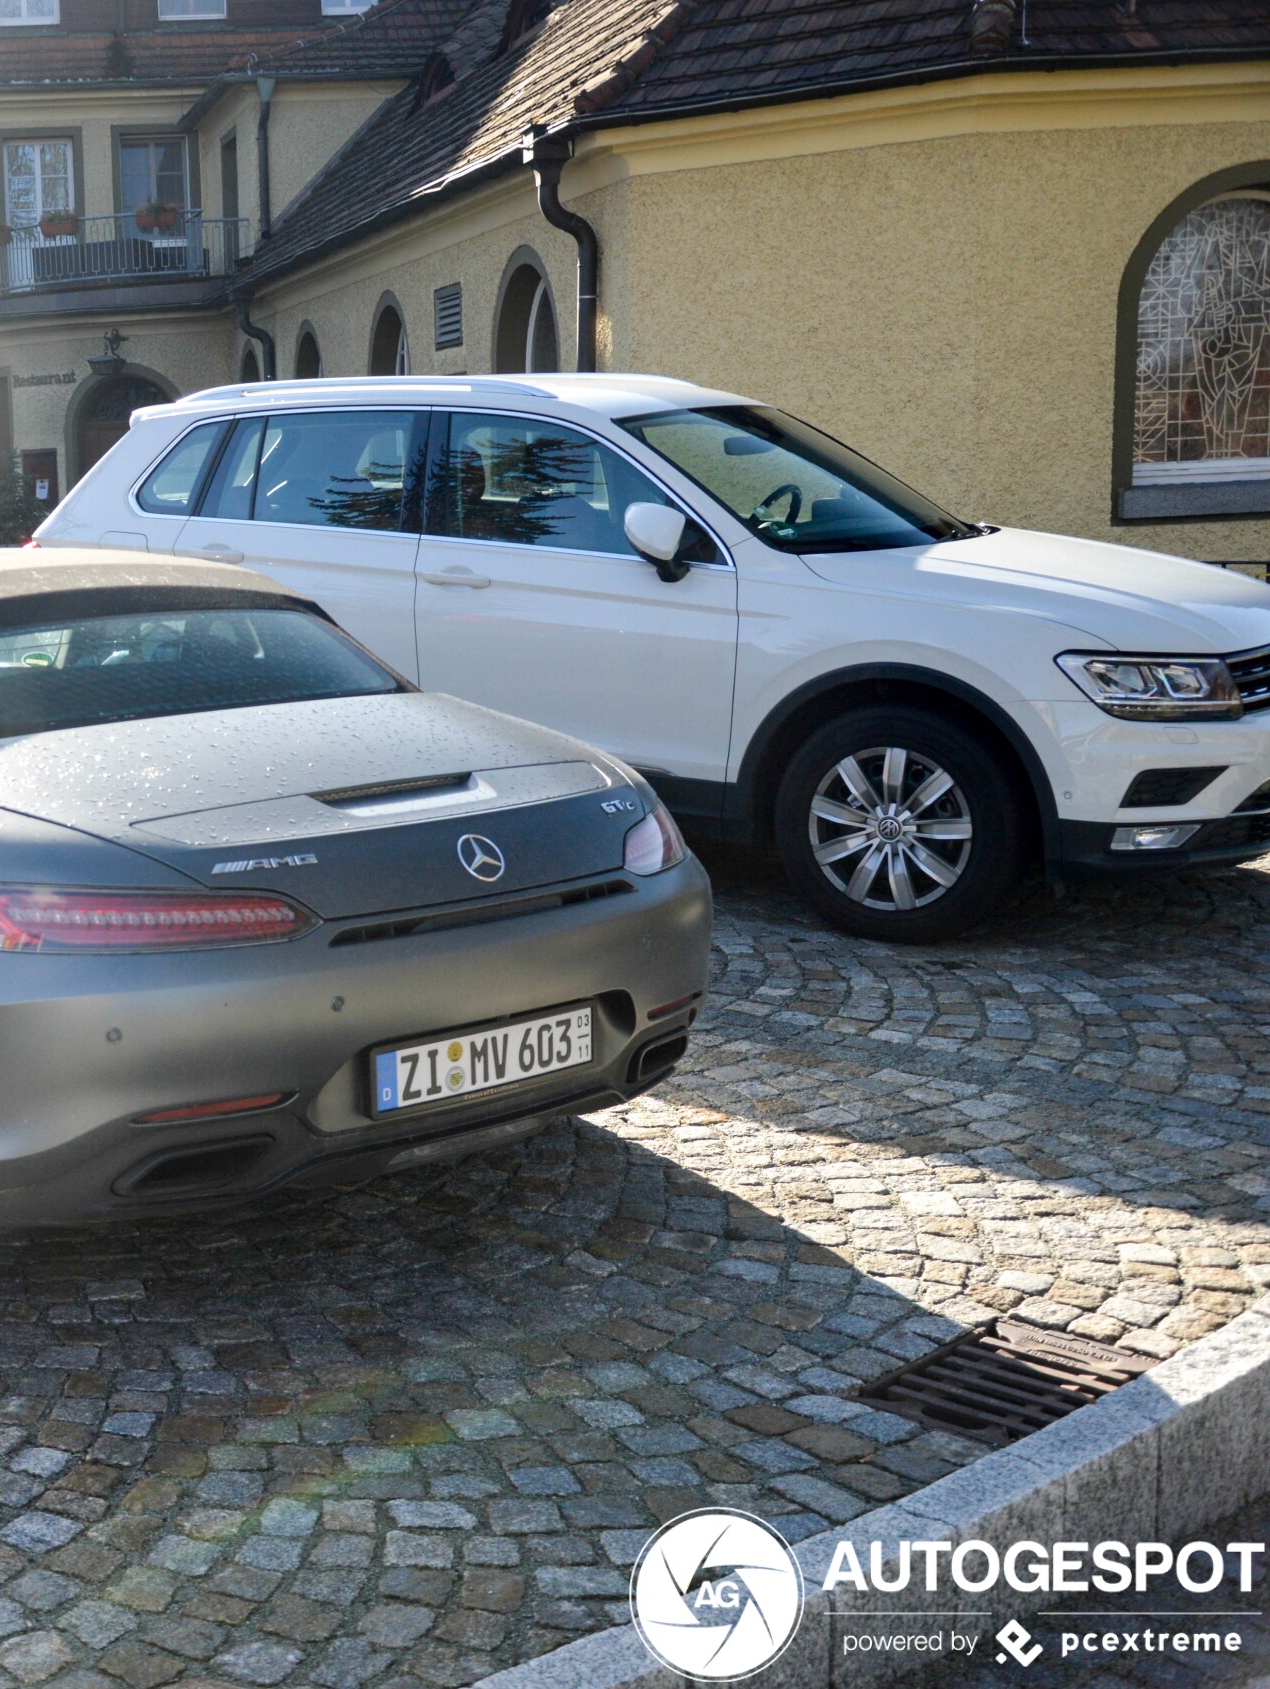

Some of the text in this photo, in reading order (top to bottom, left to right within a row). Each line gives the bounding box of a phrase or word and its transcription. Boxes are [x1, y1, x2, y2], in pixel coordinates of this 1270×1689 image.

[11, 368, 76, 388] Restaurant
[578, 1014, 589, 1028] 03
[400, 1018, 572, 1101] ZI MV 603
[383, 1087, 392, 1101] D
